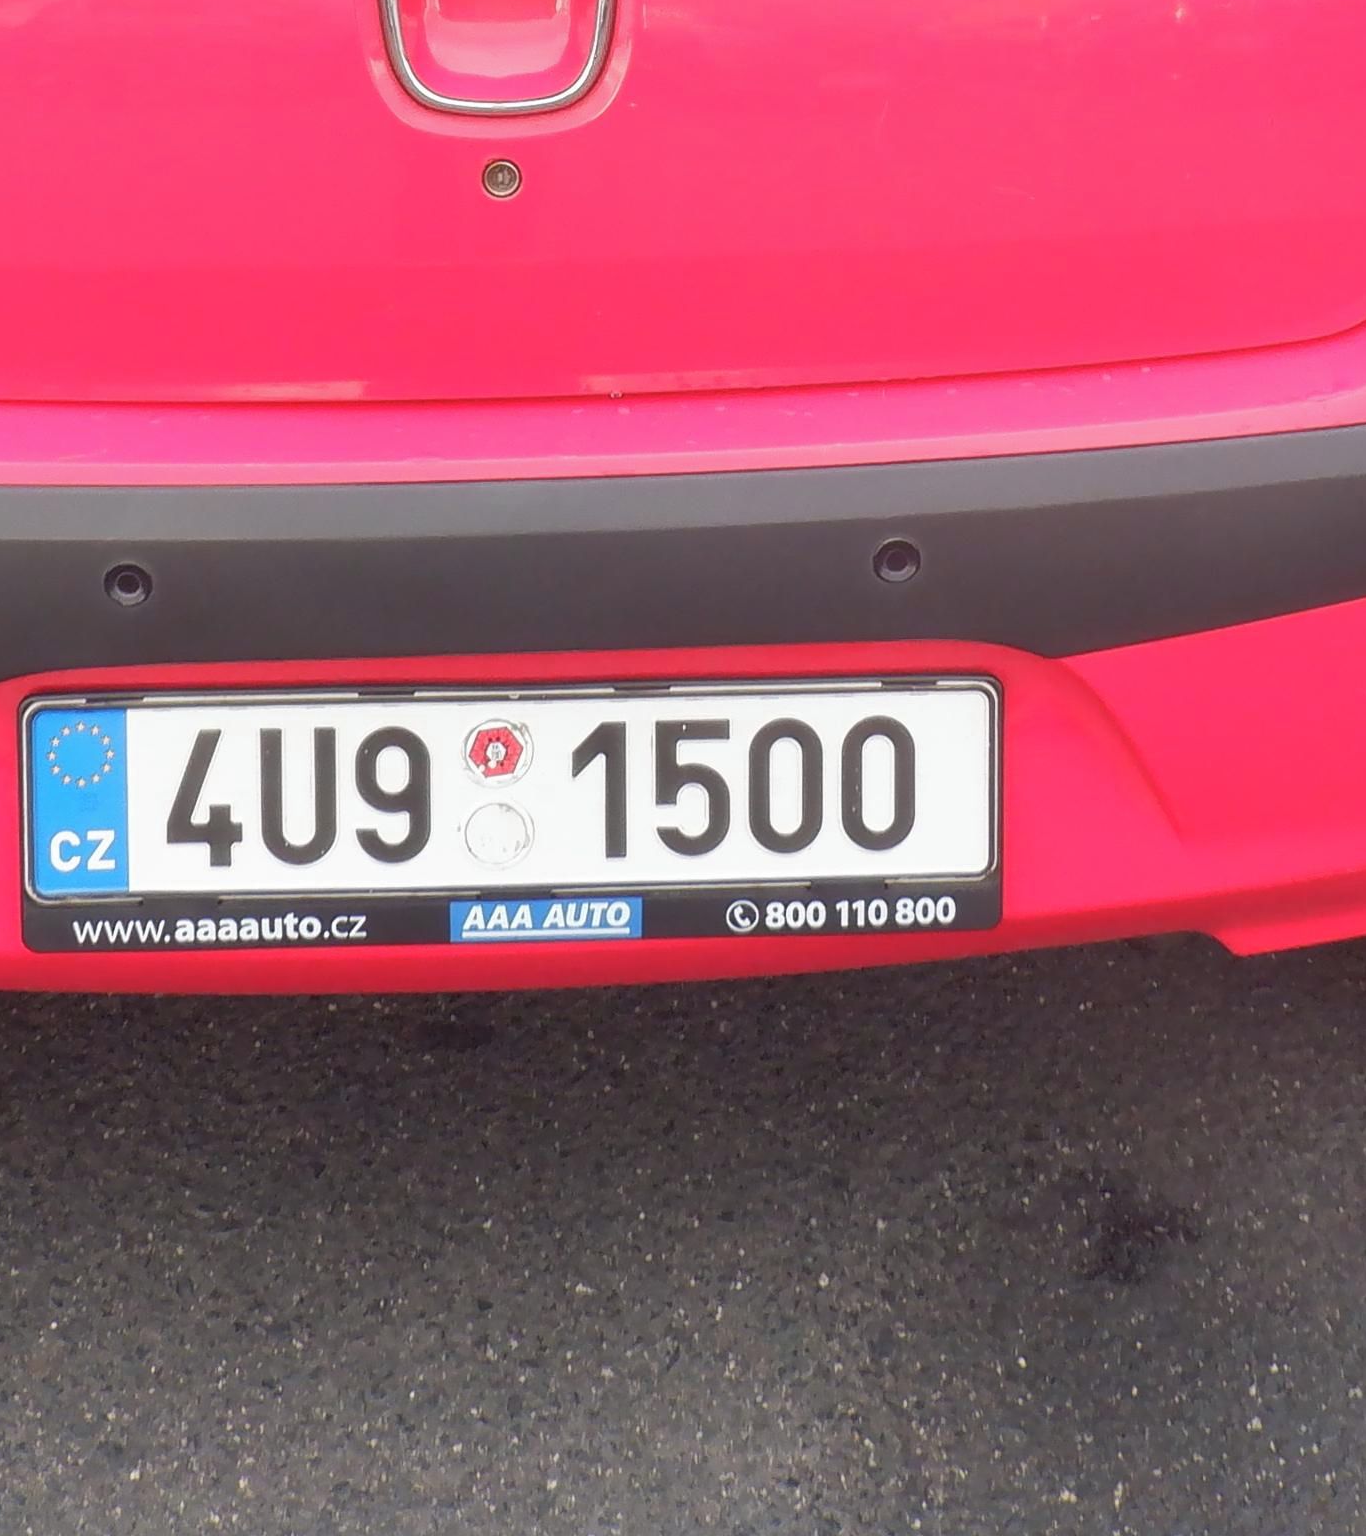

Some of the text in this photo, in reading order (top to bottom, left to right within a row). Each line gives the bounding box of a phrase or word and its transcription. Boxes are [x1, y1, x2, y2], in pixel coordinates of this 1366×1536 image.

[165, 714, 917, 868] 4U9 1500
[49, 829, 117, 872] CZ
[72, 911, 368, 945] www.aaaauto.cz
[461, 899, 631, 932] AAA AUTO
[764, 895, 957, 929] 800 110 800
